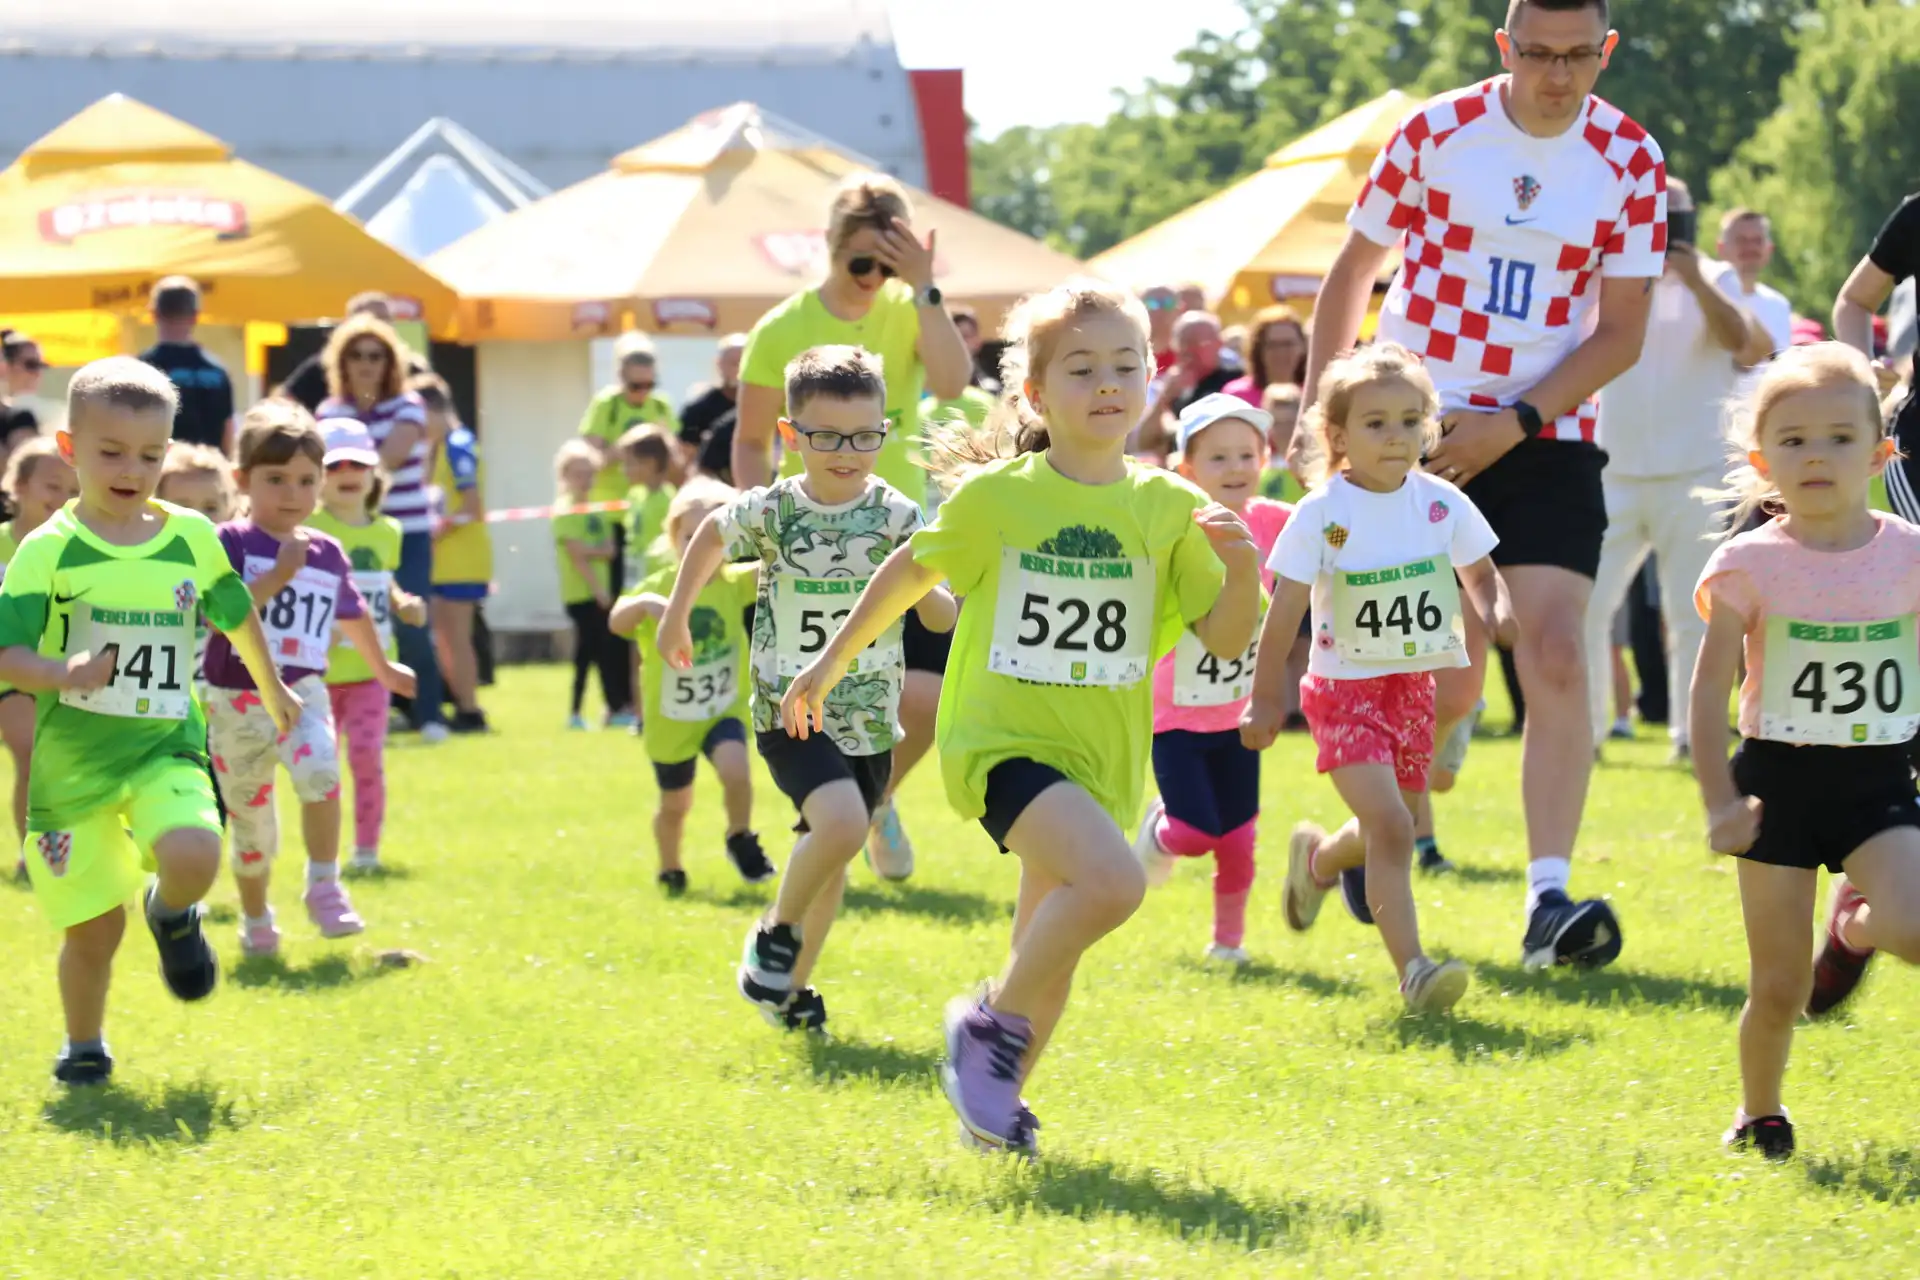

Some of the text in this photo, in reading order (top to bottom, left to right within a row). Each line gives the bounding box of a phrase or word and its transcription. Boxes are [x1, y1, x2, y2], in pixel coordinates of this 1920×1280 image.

[1483, 256, 1535, 320] 10
[1020, 552, 1085, 578] NEDELSKA
[1017, 592, 1127, 653] 528
[1355, 590, 1442, 638] 446
[675, 666, 732, 704] 532
[1791, 658, 1903, 714] 430
